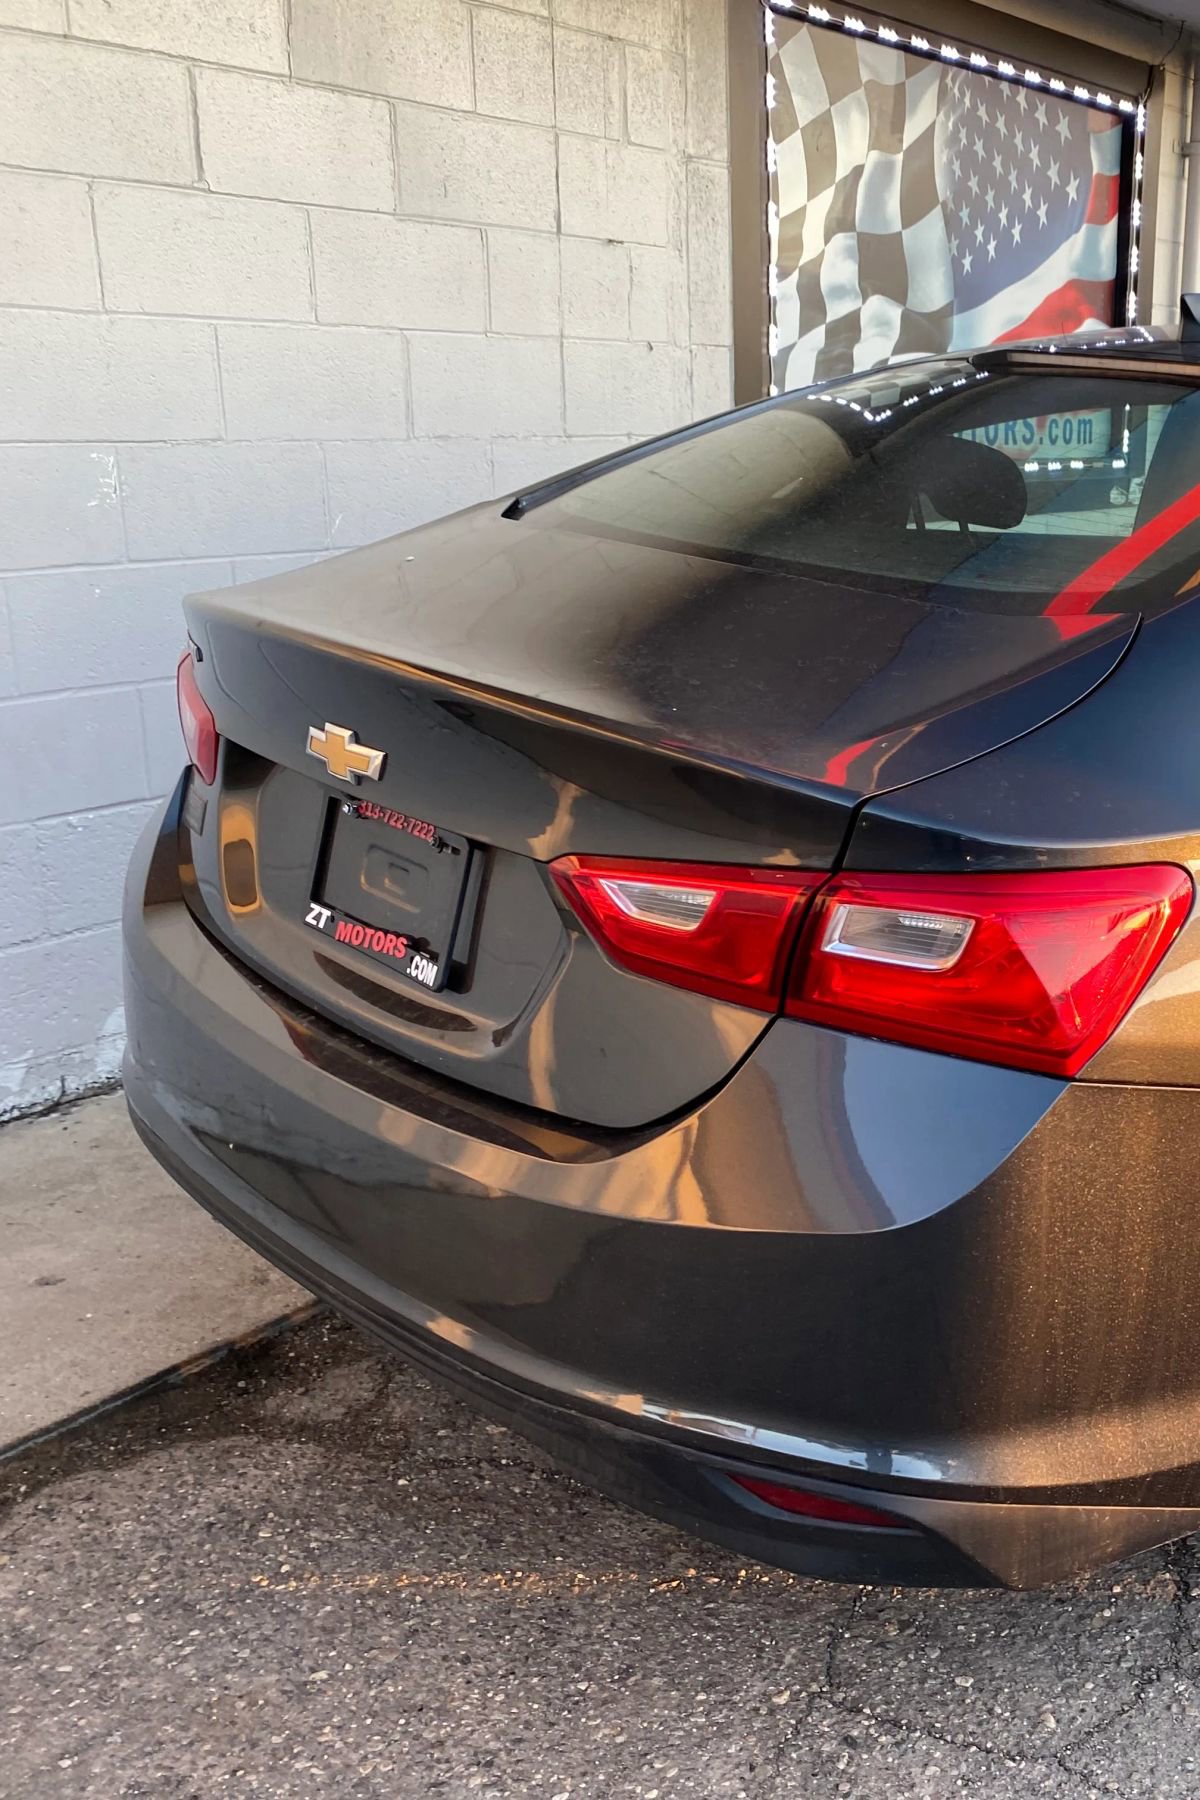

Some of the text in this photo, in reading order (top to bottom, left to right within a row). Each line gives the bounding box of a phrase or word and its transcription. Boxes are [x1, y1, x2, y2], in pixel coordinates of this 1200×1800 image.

[358, 800, 435, 842] 313-722-7222
[304, 903, 439, 987] ZT MOTORS .COM
